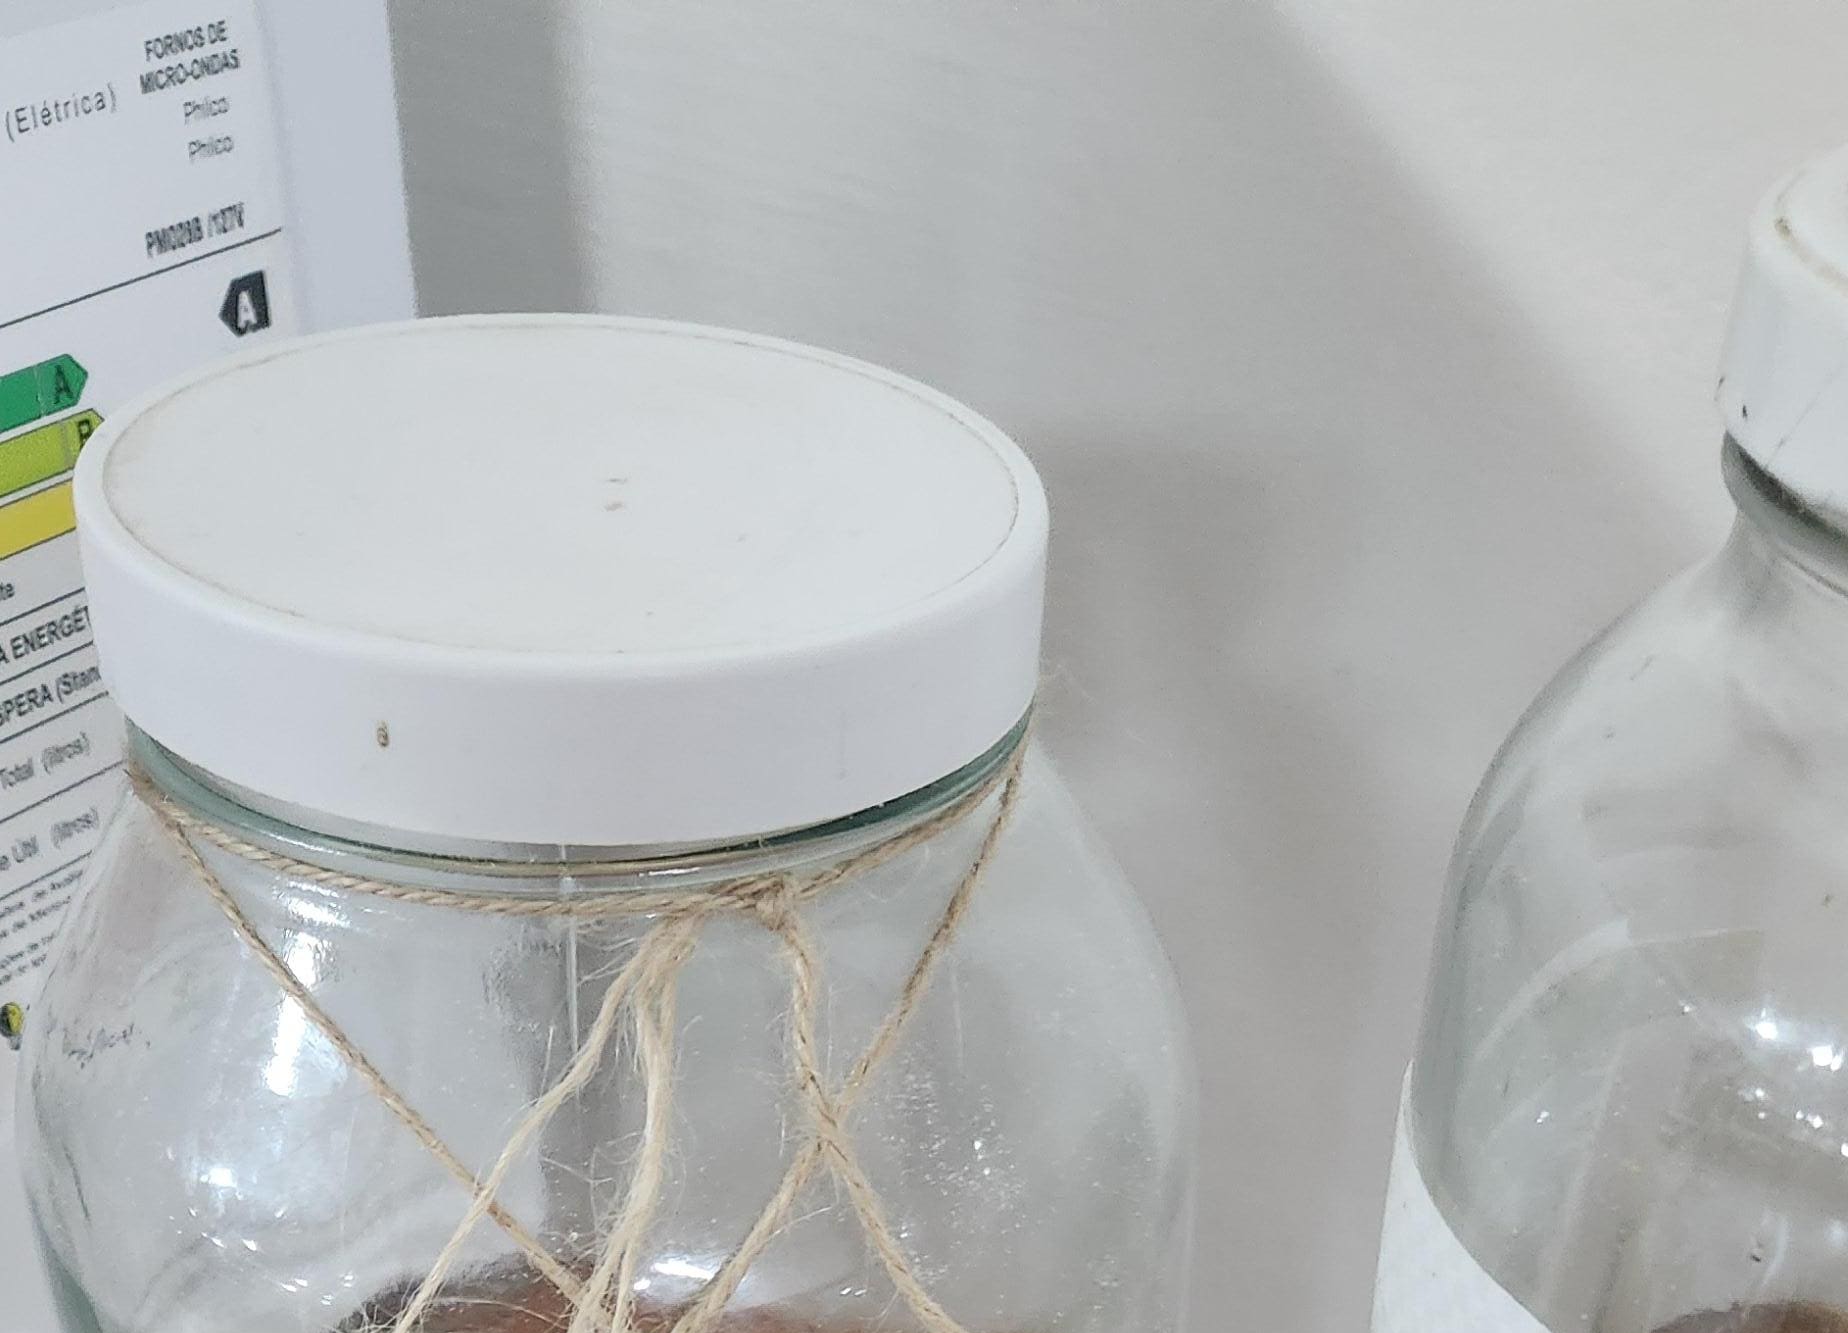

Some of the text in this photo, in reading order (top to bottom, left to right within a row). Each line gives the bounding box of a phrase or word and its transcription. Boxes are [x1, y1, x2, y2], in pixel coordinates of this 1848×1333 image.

[144, 19, 228, 61] FORNOS DE
[140, 49, 240, 94] MICRO-ONDAS
[5, 83, 117, 142] (Elétrica)
[236, 289, 259, 329] A
[53, 364, 74, 405] A
